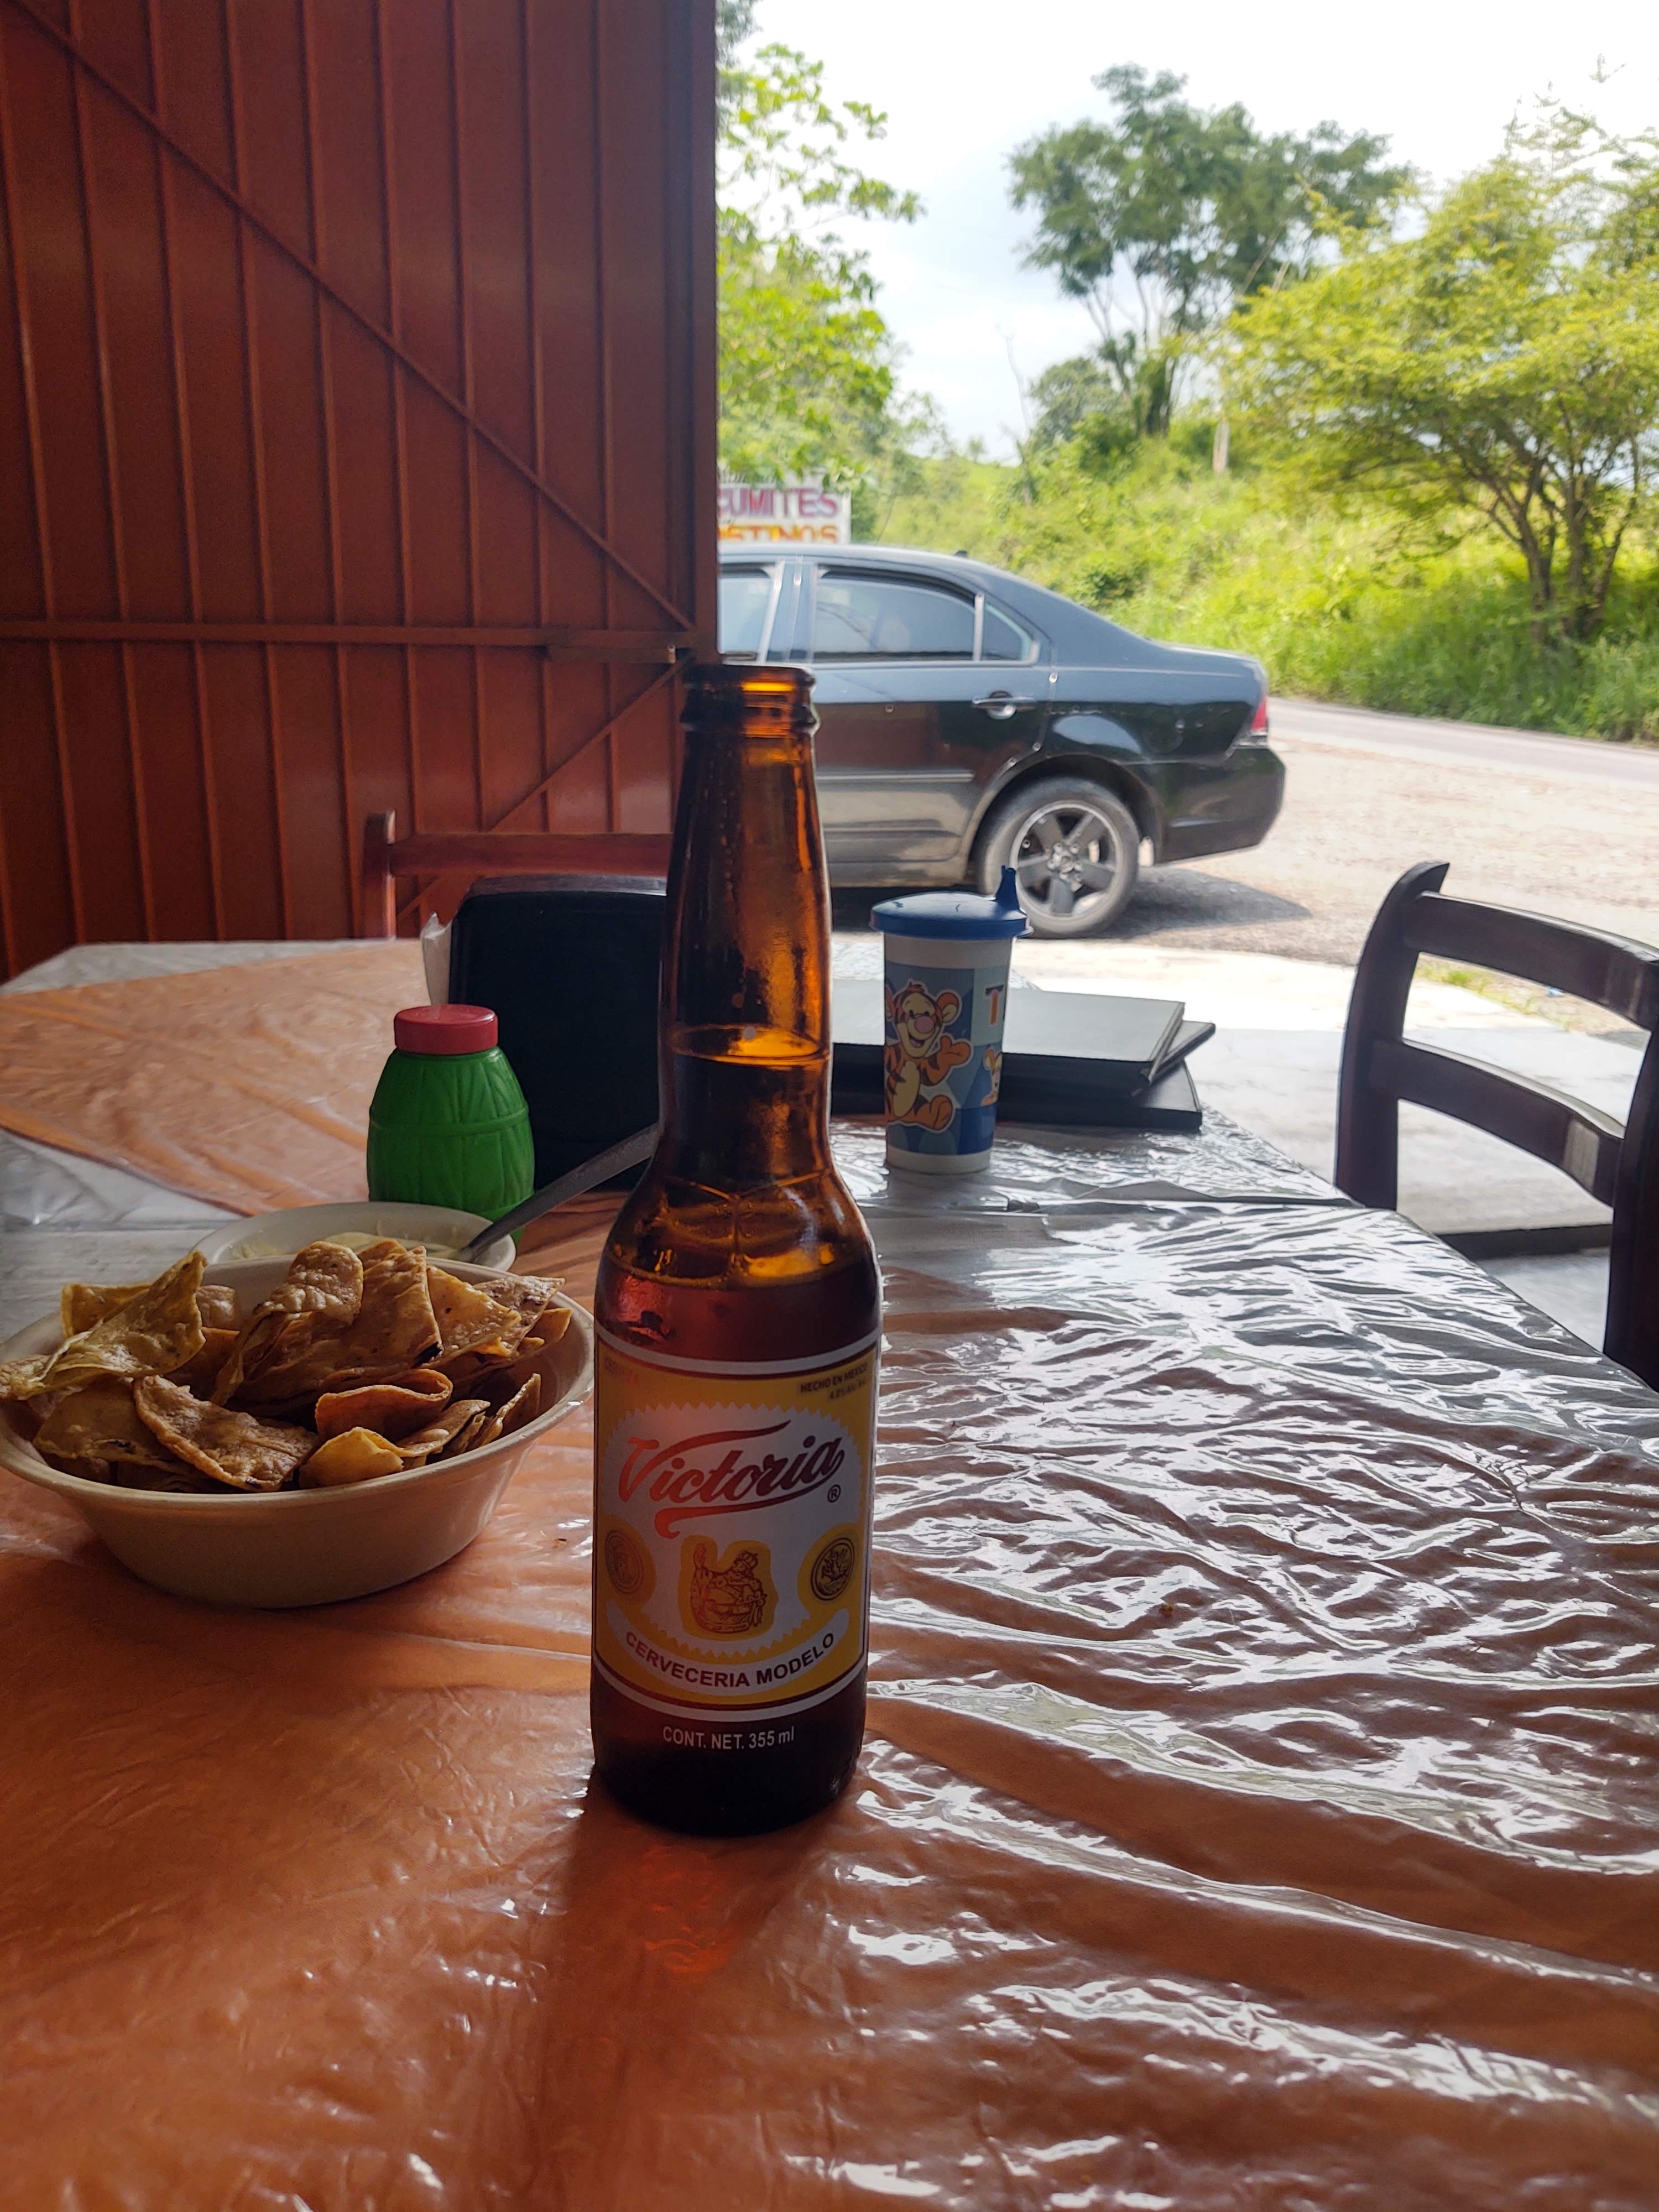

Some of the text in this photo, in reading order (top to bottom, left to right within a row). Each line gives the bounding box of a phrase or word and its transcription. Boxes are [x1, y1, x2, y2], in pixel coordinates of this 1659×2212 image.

[985, 985, 1006, 1025] T
[800, 1378, 831, 1393] HECHO
[832, 1375, 843, 1386] EN
[618, 1420, 845, 1538] Victoria
[626, 1631, 834, 1687] CERVECERIA MODELO
[663, 1725, 795, 1750] CONT. NET. 355 ml
